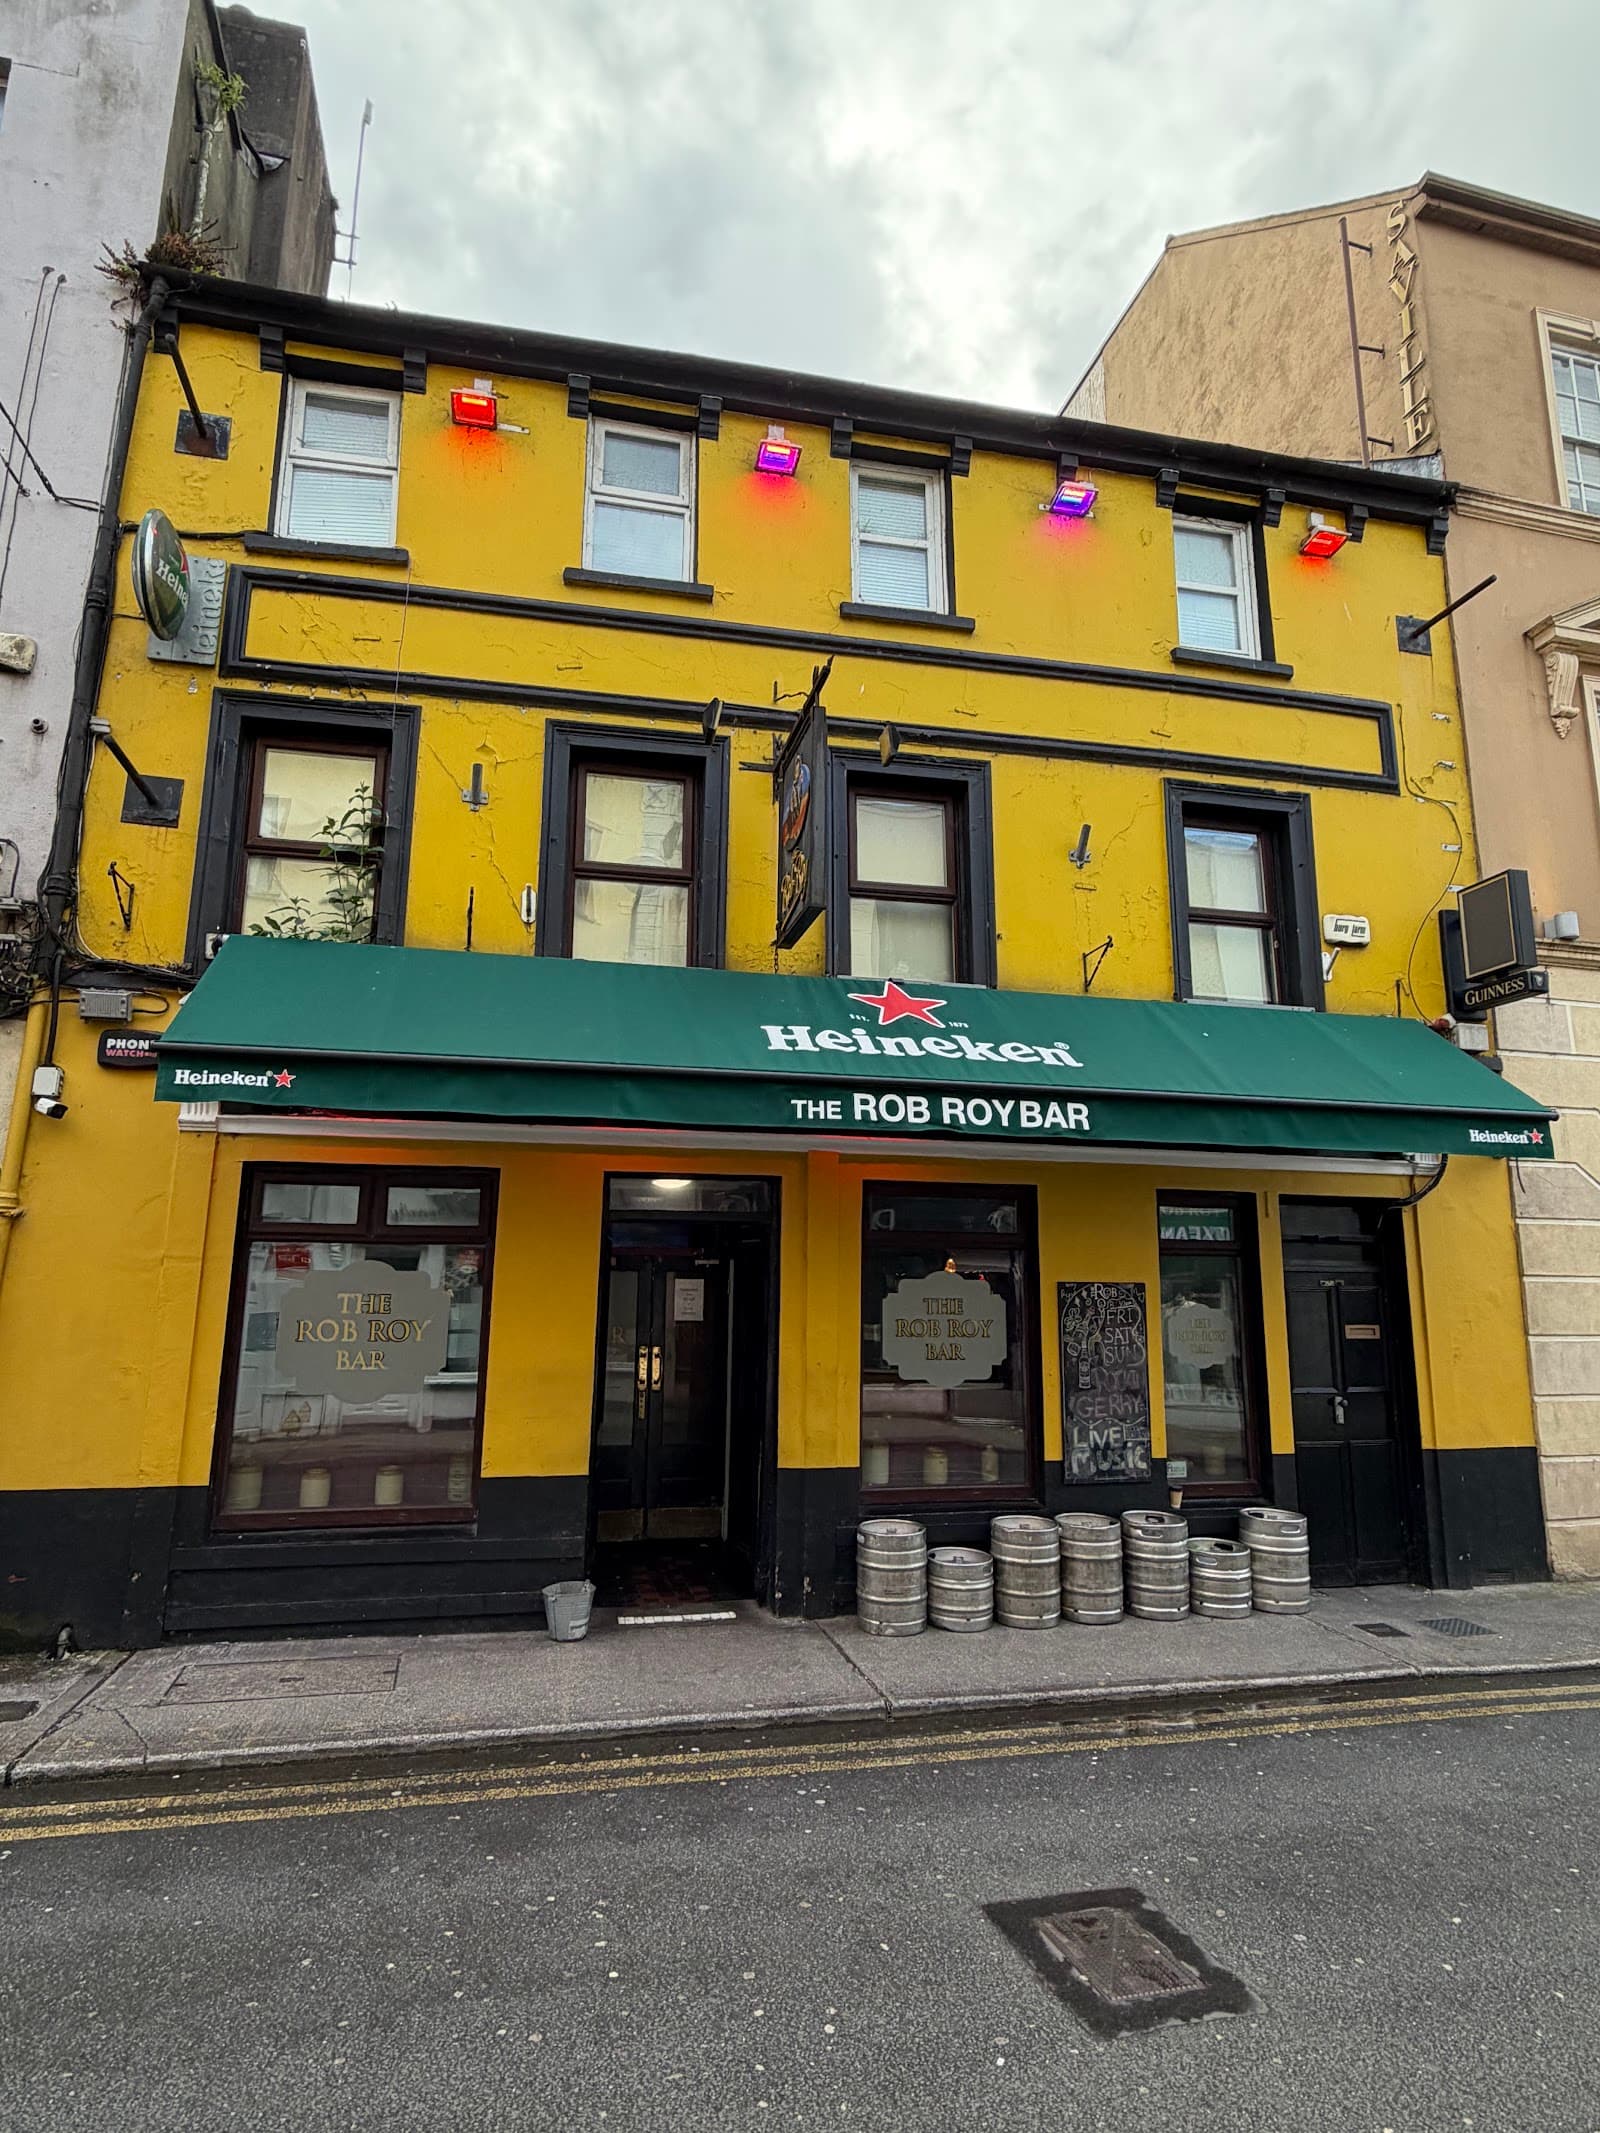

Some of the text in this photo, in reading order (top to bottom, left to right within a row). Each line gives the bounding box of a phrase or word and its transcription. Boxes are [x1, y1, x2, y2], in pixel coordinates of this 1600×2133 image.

[1386, 199, 1432, 453] SAVILLE
[1464, 976, 1526, 1007] GUINNESS
[105, 1049, 144, 1058] WATCH
[106, 1038, 153, 1050] PHON
[760, 1025, 1084, 1067] Heineken
[174, 1069, 270, 1087] Heineken
[790, 1098, 843, 1120] THE
[853, 1092, 931, 1124] ROB
[1469, 1128, 1528, 1145] Heineken
[336, 1293, 392, 1315] THE
[922, 1297, 965, 1316] THE
[1106, 1307, 1133, 1325] FRI
[295, 1319, 431, 1343] ROB ROY
[895, 1318, 994, 1338] ROB ROY
[1104, 1326, 1132, 1346] SAT
[335, 1350, 386, 1371] BAR
[925, 1343, 966, 1361] BAR
[1105, 1343, 1137, 1364] SUN
